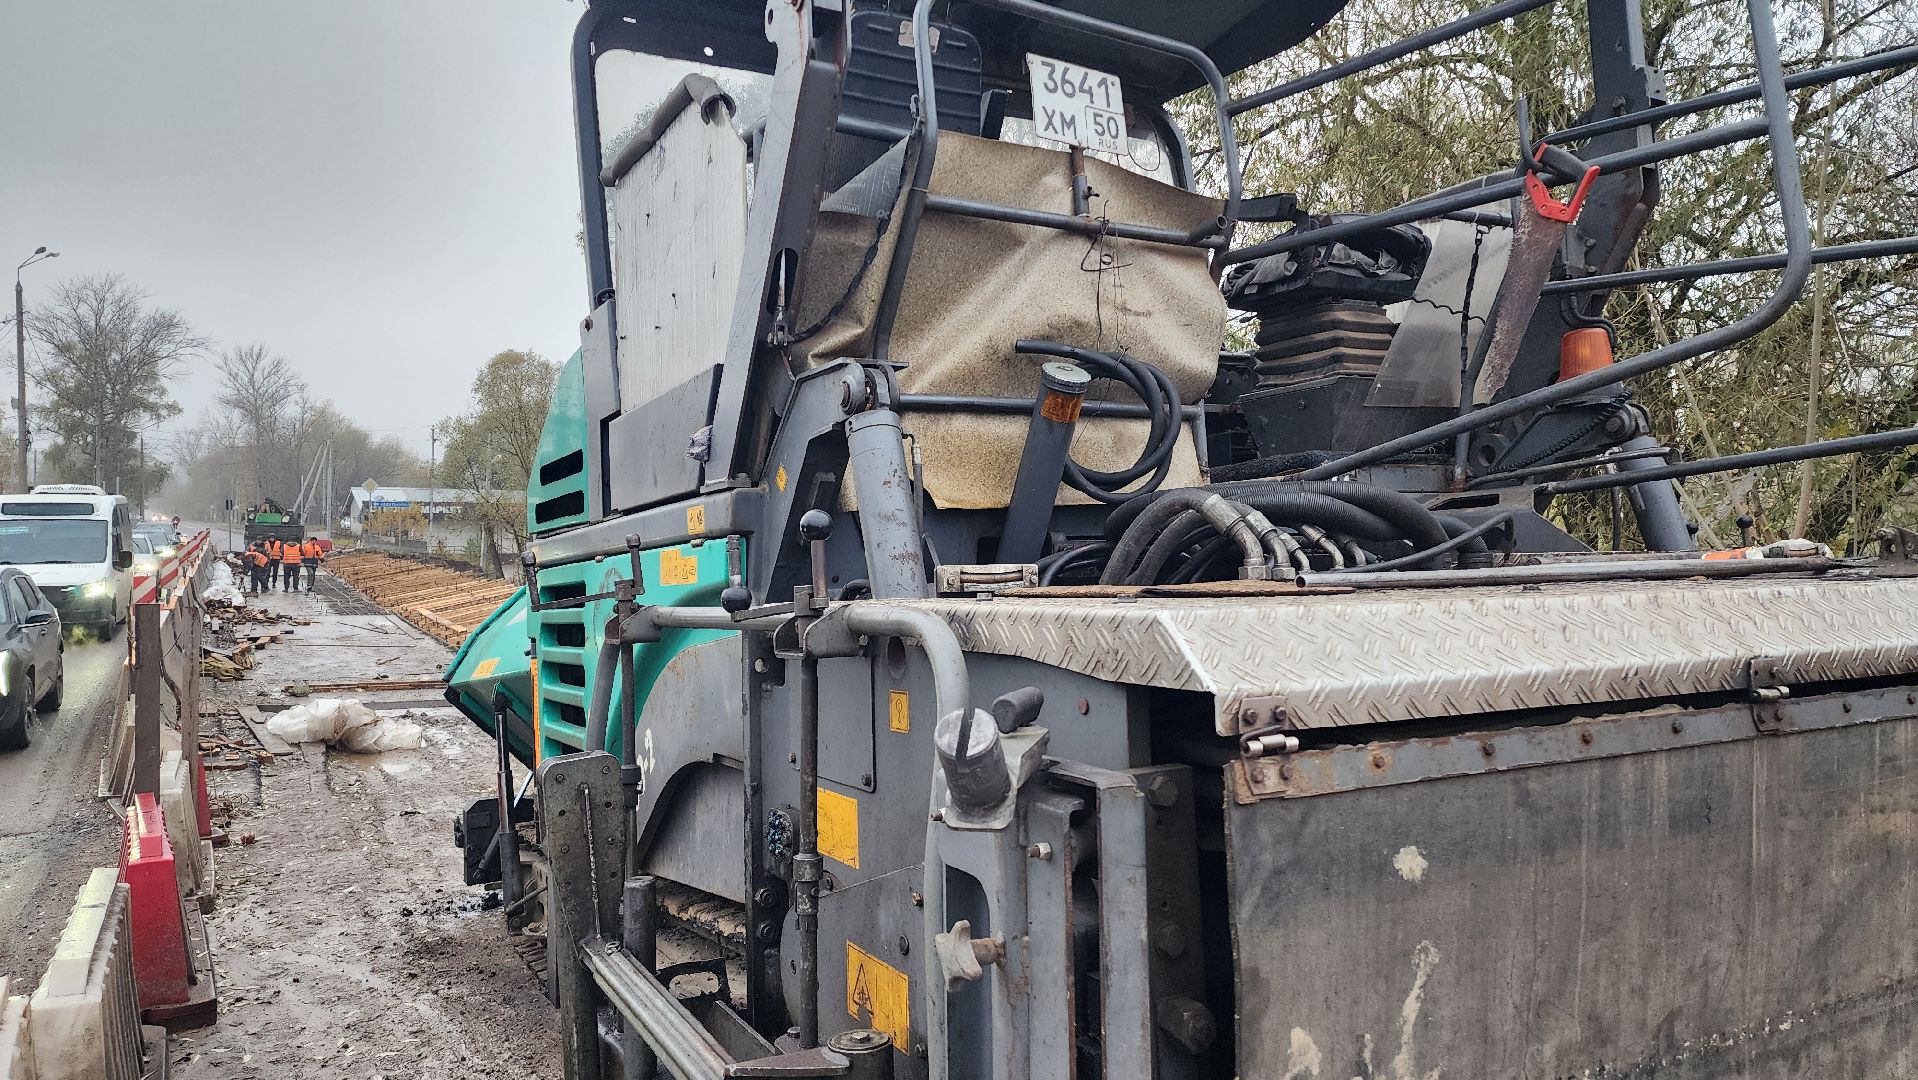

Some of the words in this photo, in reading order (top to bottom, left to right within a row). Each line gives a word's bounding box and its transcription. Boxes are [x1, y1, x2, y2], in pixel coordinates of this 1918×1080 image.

[1041, 61, 1110, 108] 3641
[1042, 105, 1078, 139] ХМ
[1093, 112, 1119, 139] 50
[1098, 138, 1118, 150] RUS
